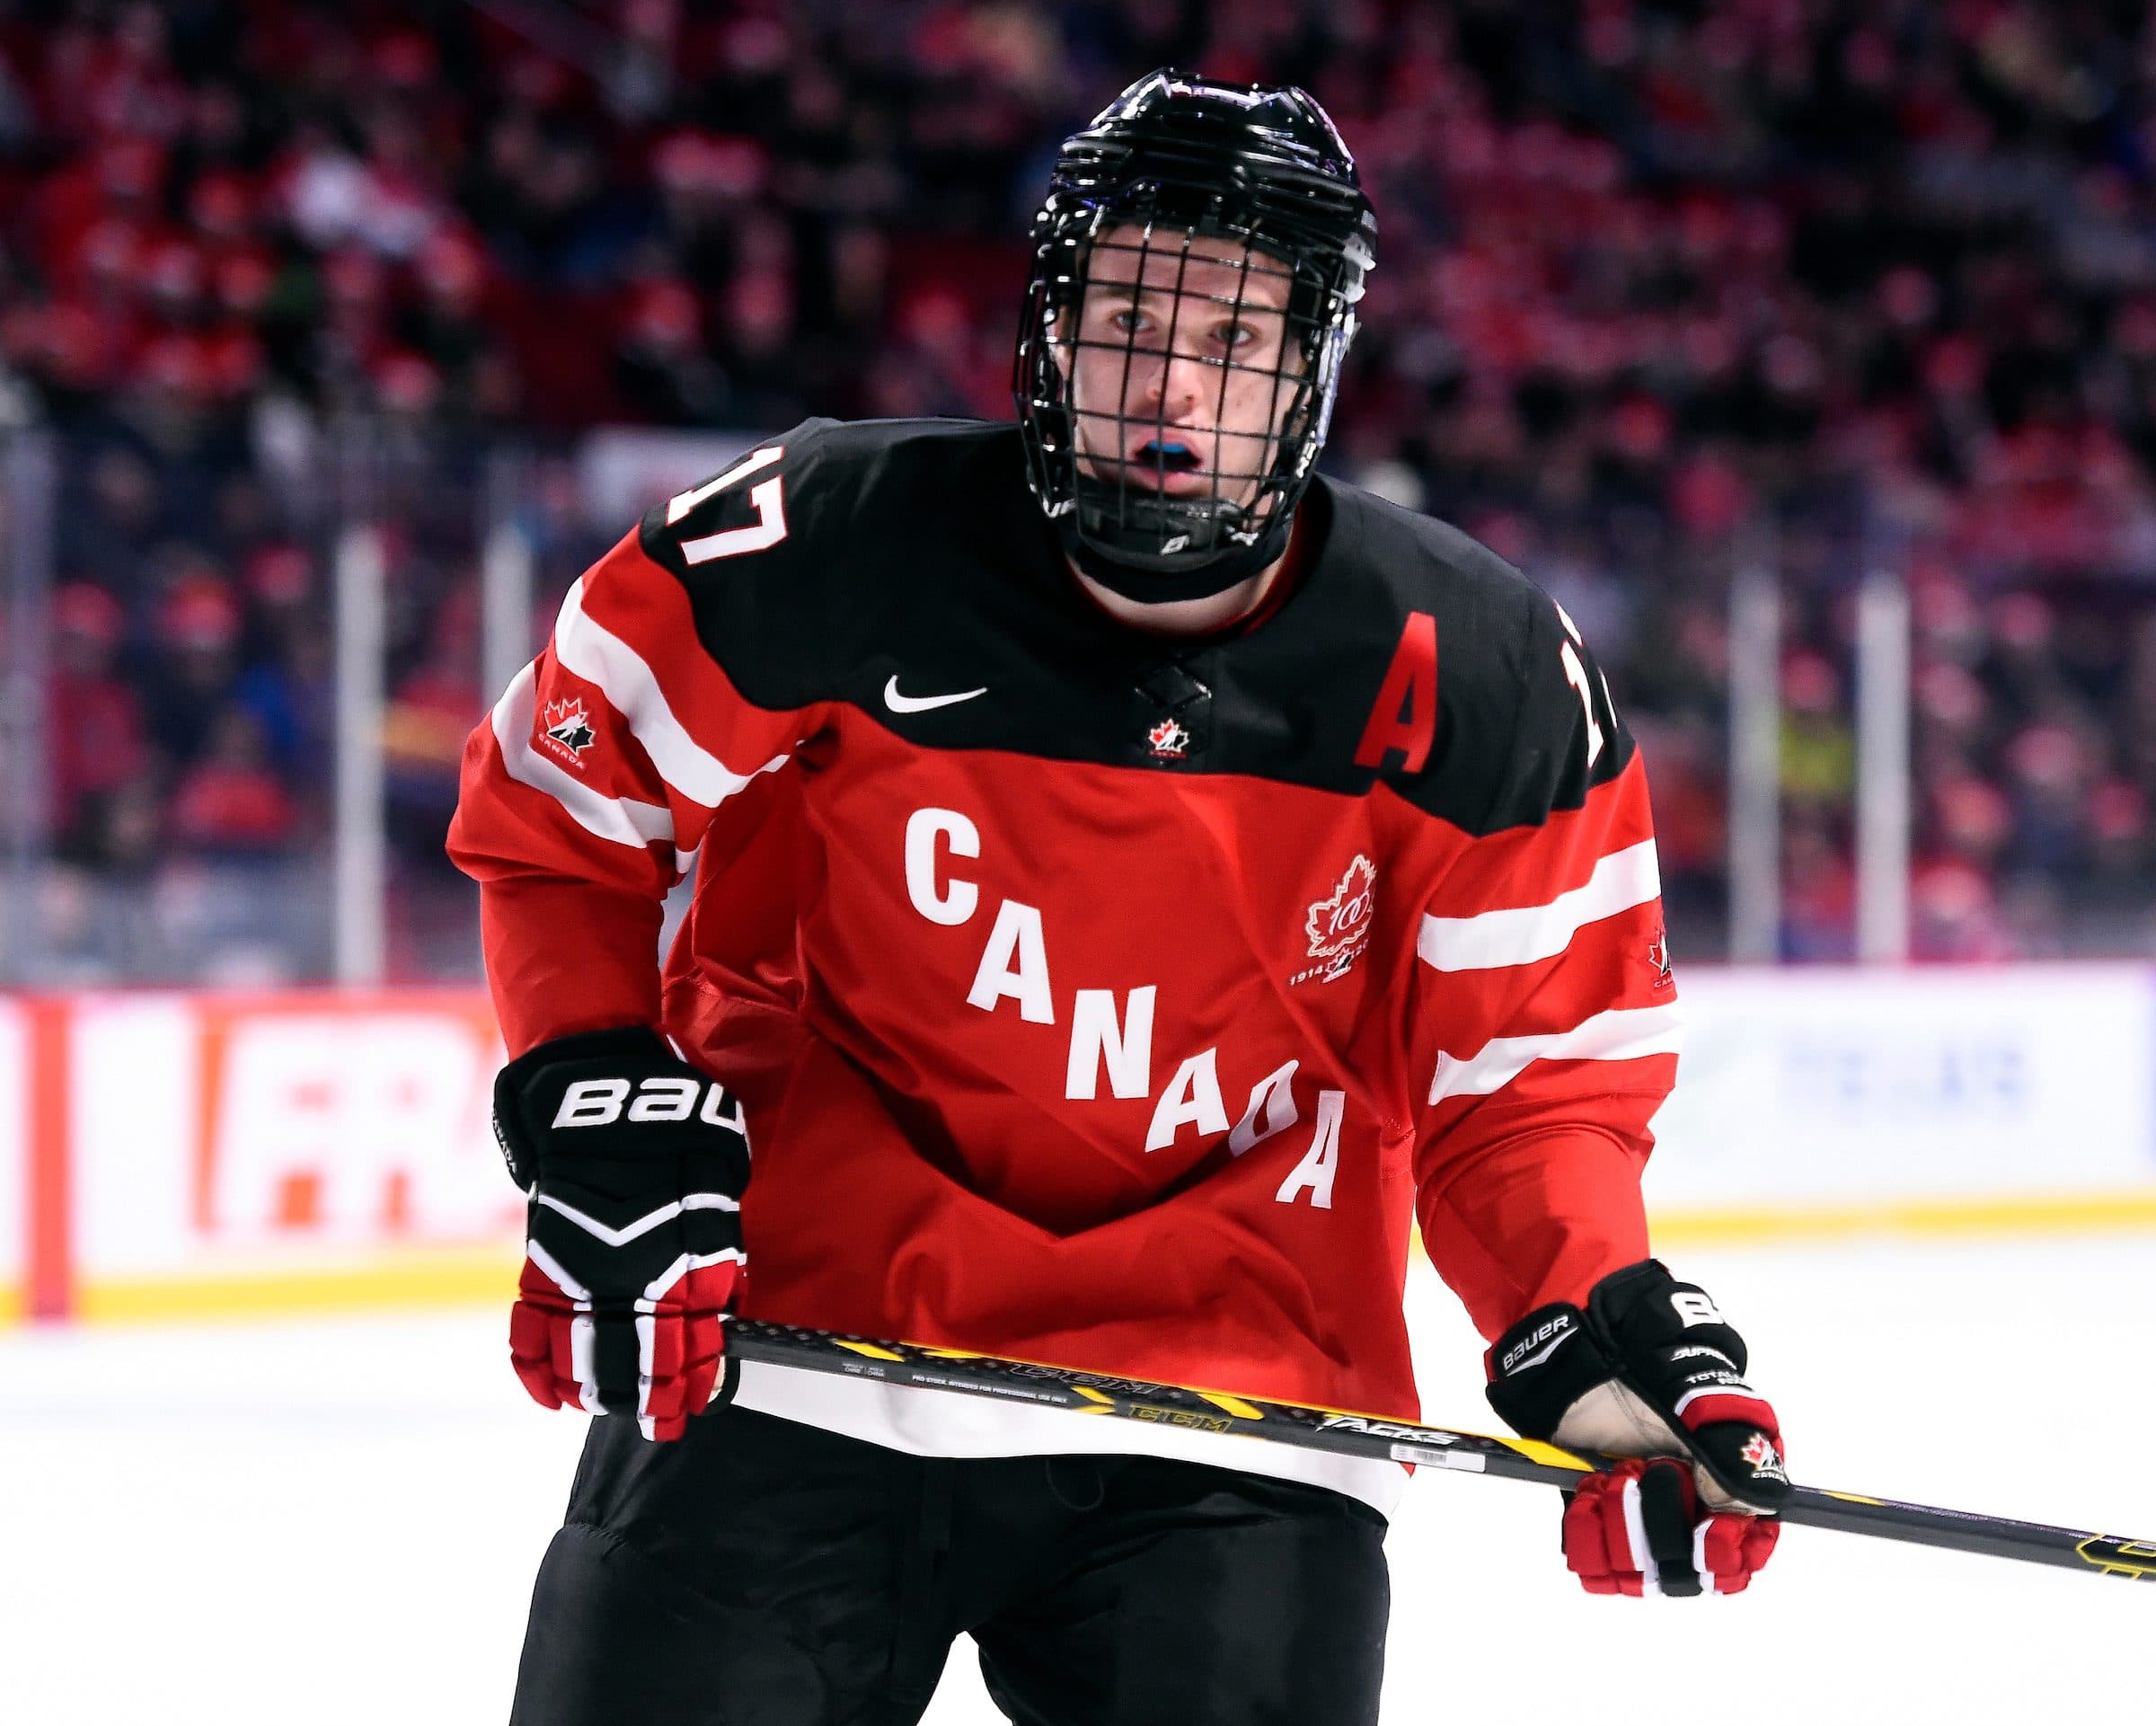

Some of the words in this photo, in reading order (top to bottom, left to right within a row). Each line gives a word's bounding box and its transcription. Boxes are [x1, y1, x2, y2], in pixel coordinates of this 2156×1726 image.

[667, 446, 789, 565] 17
[1353, 611, 1436, 774] A
[538, 733, 584, 769] CANADA
[905, 808, 1346, 1209] CANADA
[1290, 965, 1324, 987] 1914
[1128, 1403, 1235, 1434] CCM
